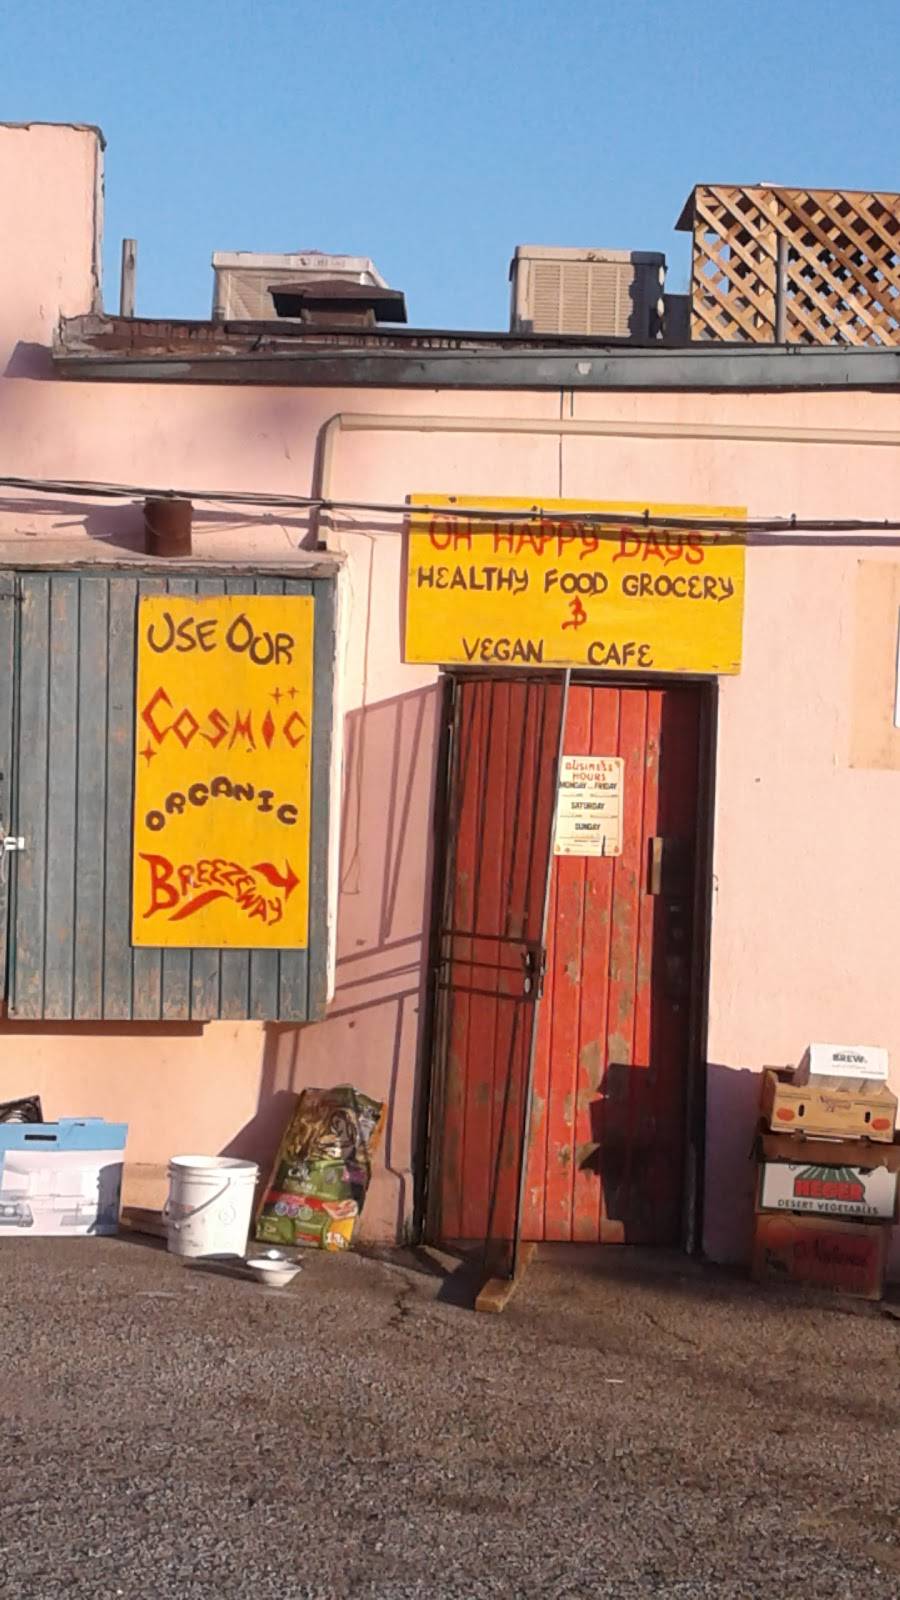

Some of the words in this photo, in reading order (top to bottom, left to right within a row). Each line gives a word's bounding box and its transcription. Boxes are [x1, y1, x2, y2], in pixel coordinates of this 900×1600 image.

[428, 514, 472, 551] OH
[493, 519, 600, 560] HAPPY
[417, 565, 529, 596] HEALTHY
[544, 568, 609, 597] FOOD
[621, 571, 734, 602] GROCERY
[147, 612, 218, 653] USE
[226, 613, 295, 665] OUR
[462, 637, 544, 663] VEGAN
[587, 641, 654, 667] CAFE
[141, 686, 306, 750] COSMIC
[572, 772, 606, 782] HOURS
[594, 782, 617, 790] FRIDAY
[571, 801, 605, 810] SATURDAY
[138, 852, 283, 926] BREEZEWAY
[777, 1199, 814, 1209] DESERT
[817, 1202, 879, 1215] VEGETABLES
